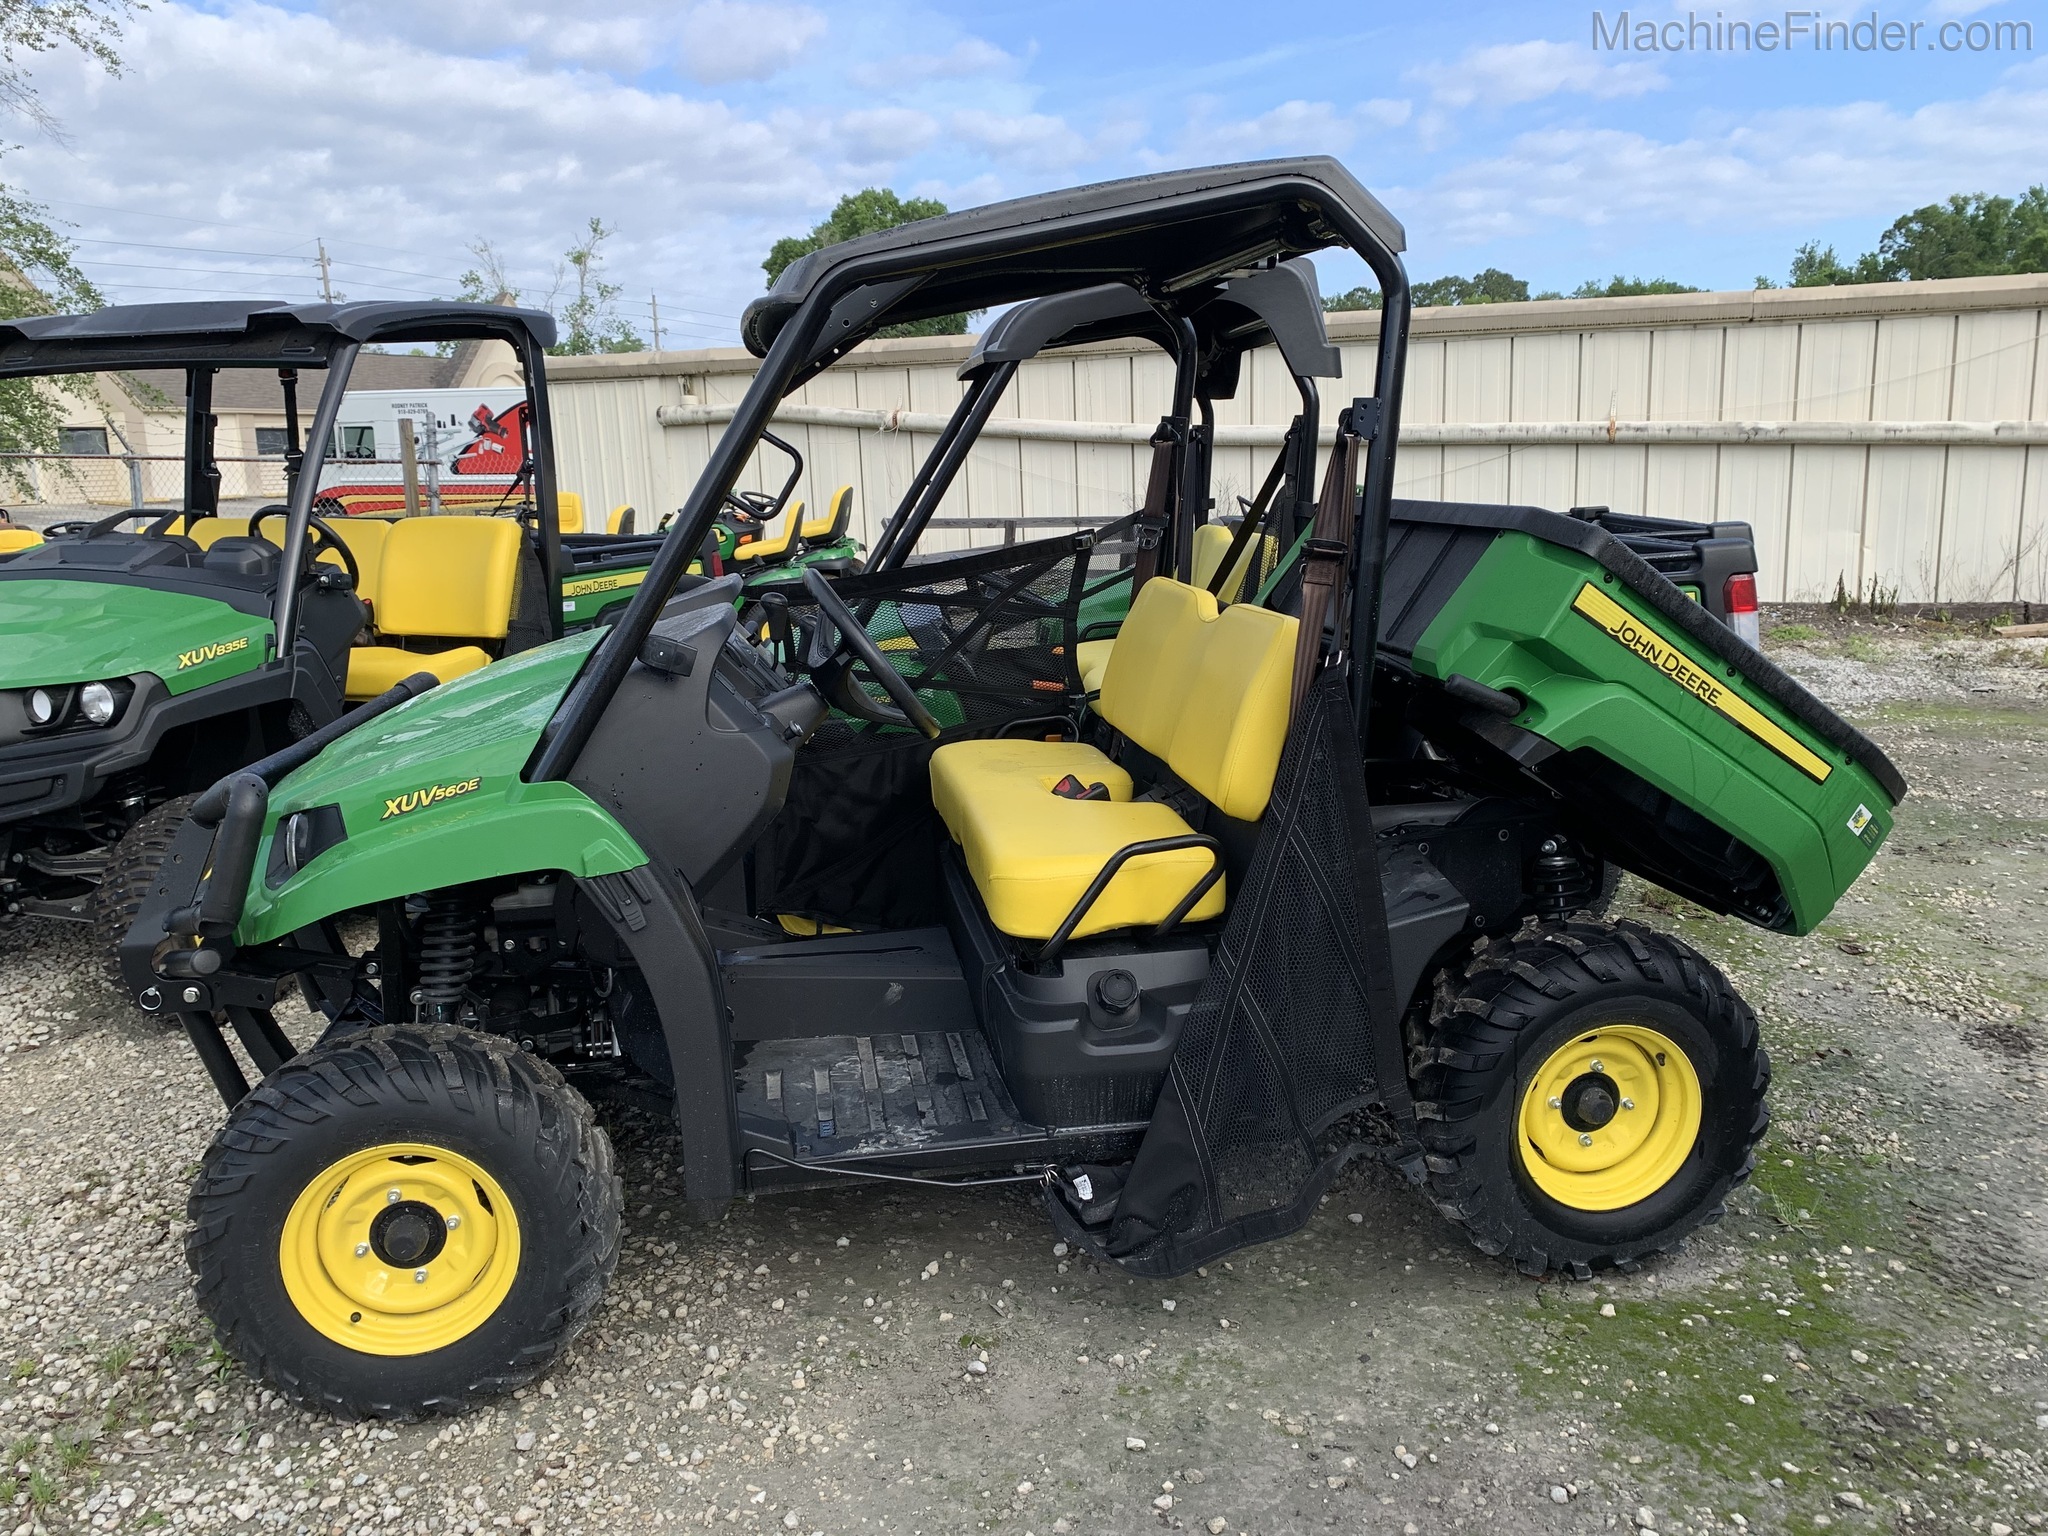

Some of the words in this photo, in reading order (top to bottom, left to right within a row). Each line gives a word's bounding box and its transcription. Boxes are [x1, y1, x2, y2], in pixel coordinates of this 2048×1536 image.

[571, 583, 592, 595] JOHN
[593, 579, 618, 591] DEERE
[178, 637, 249, 670] XUV835E
[1610, 620, 1661, 662] JOHN
[1660, 652, 1722, 706] DEERE
[381, 777, 482, 820] XUV560E
